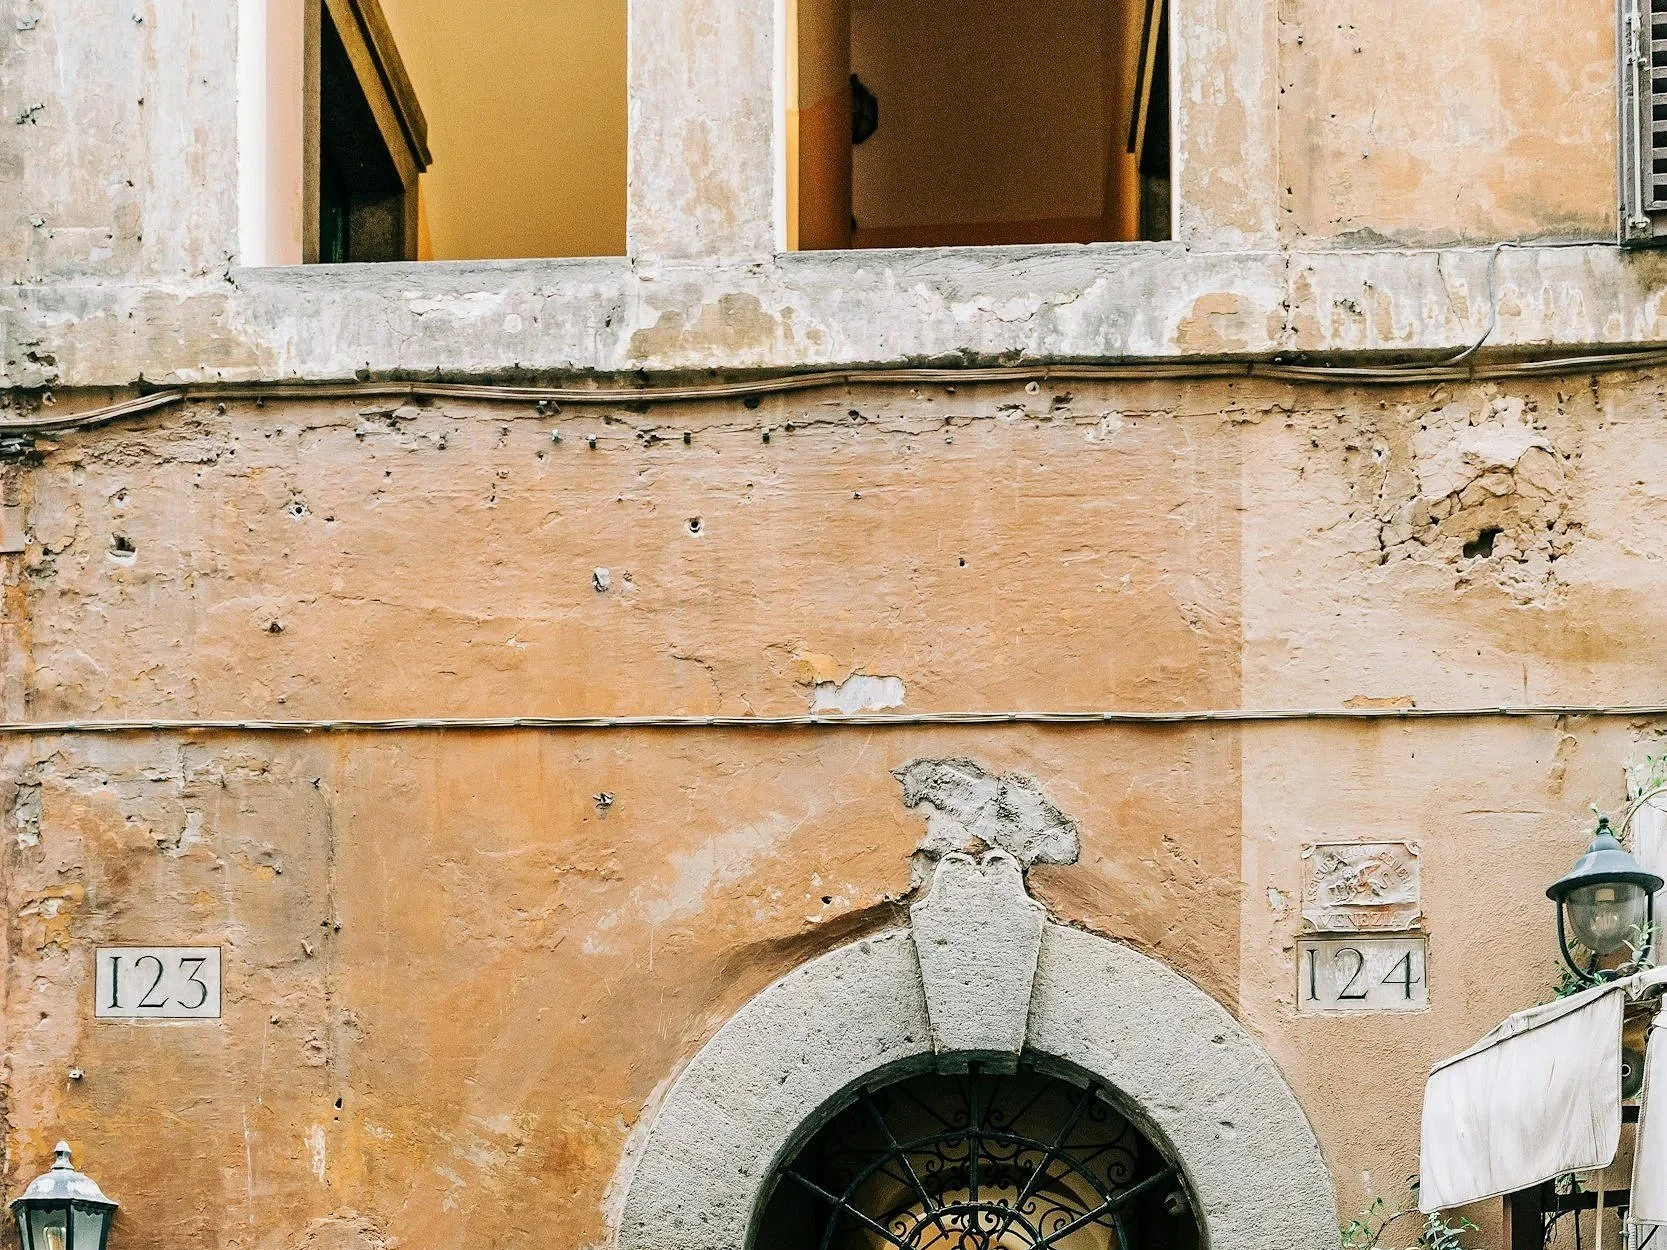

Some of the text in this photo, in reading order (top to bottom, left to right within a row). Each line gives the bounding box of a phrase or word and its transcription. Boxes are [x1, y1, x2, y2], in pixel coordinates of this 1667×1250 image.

[1318, 913, 1403, 927] VENEZIA
[107, 955, 208, 1009] 123
[1306, 947, 1421, 1001] 124
